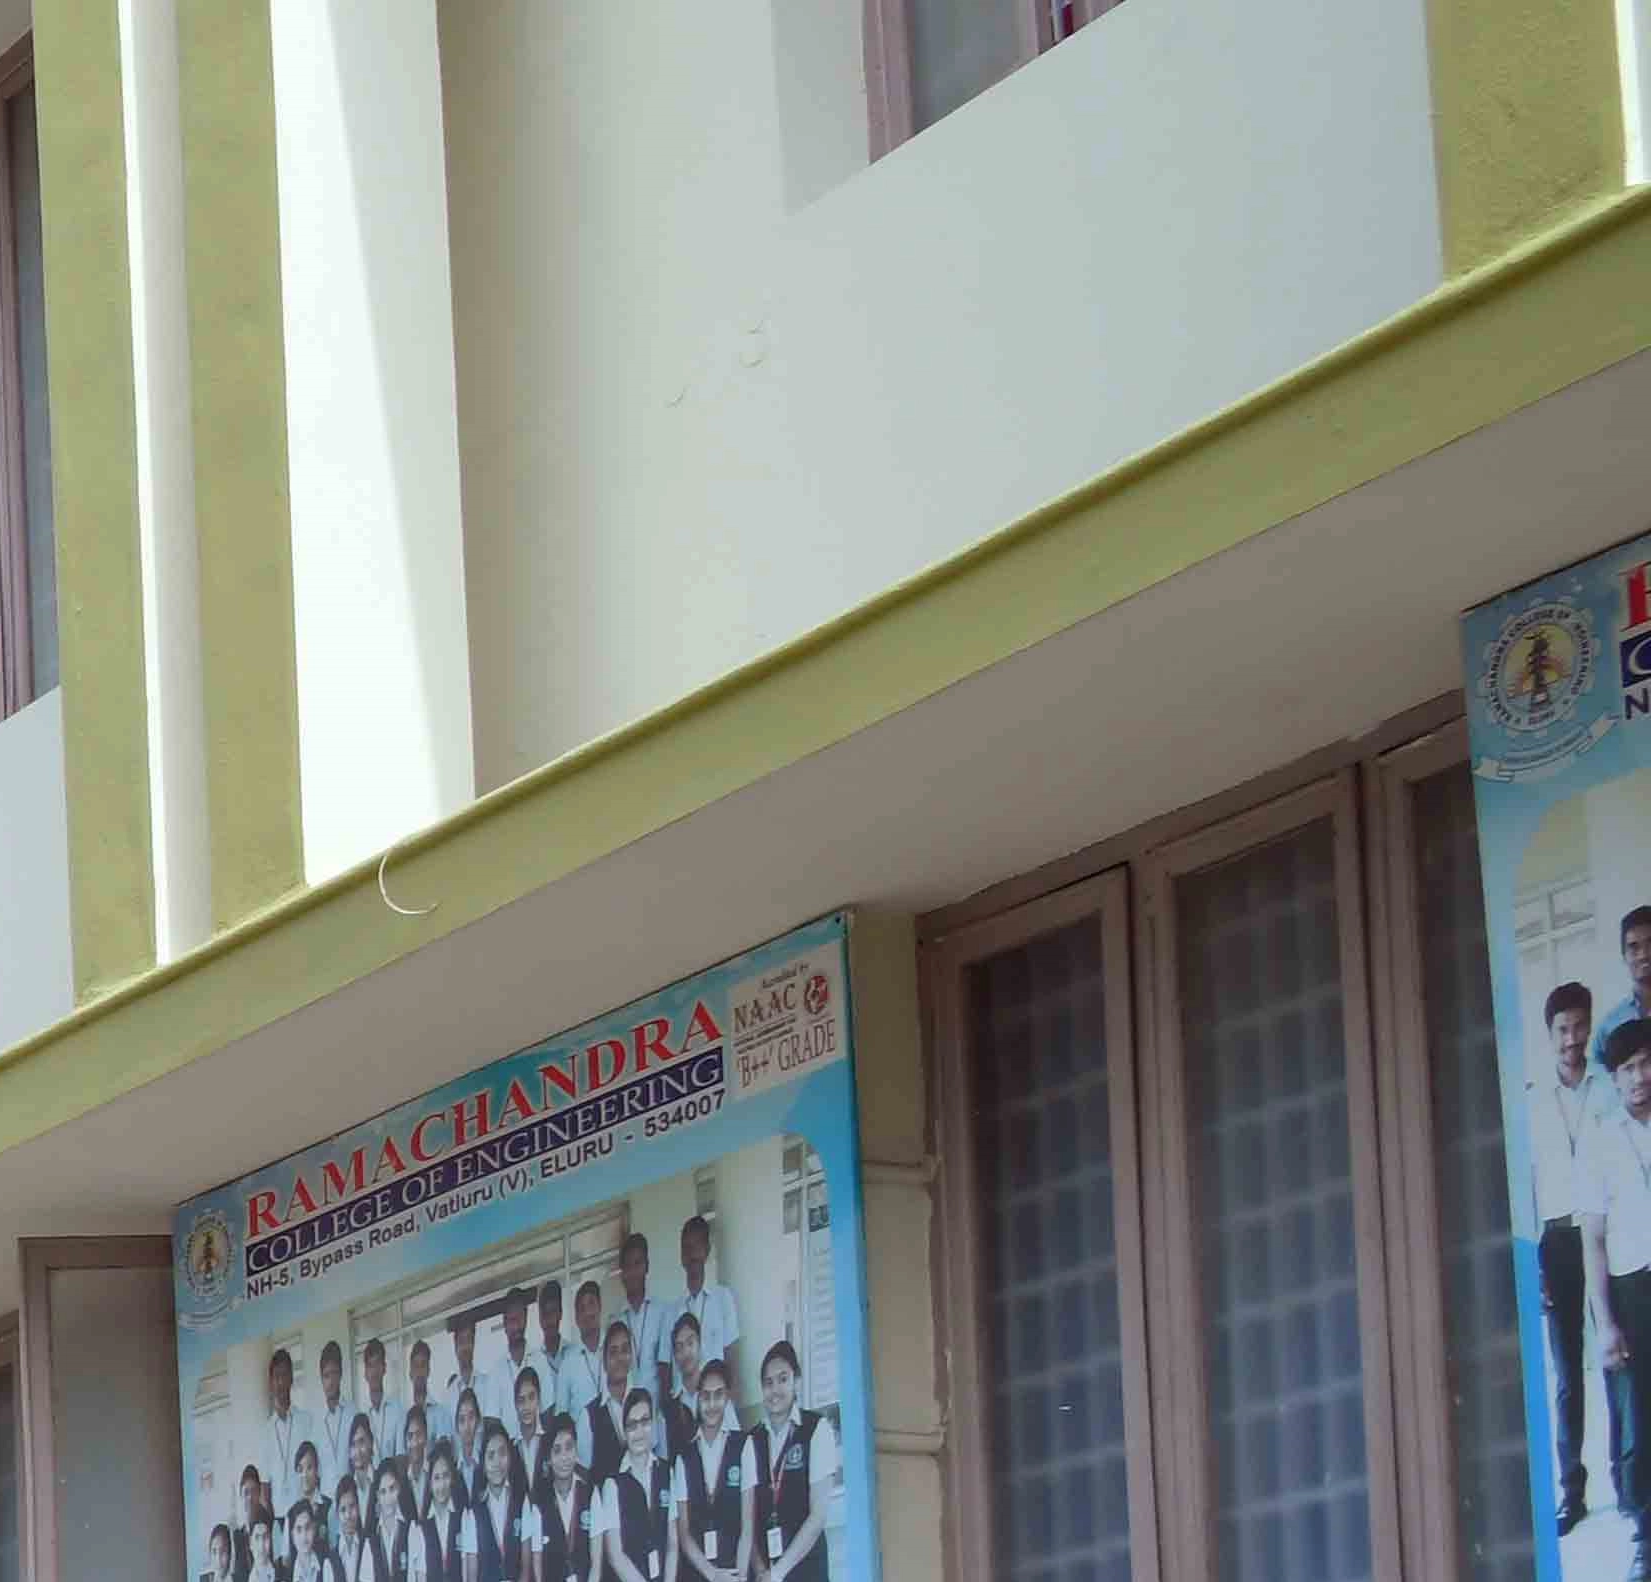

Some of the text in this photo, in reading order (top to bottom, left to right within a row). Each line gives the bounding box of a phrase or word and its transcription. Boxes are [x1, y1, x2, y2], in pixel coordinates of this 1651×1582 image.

[734, 982, 796, 1034] NAAC
[777, 1018, 836, 1071] GRADE
[247, 1000, 723, 1239] RAMACHANDRA
[249, 1189, 392, 1272] COLLEGE
[402, 1168, 443, 1205] OF
[456, 1052, 721, 1185] ENGINEERING
[300, 1240, 364, 1279] Bypass
[369, 1213, 420, 1248] Road,
[540, 1132, 614, 1179] ELURU
[645, 1089, 726, 1137] 534007
